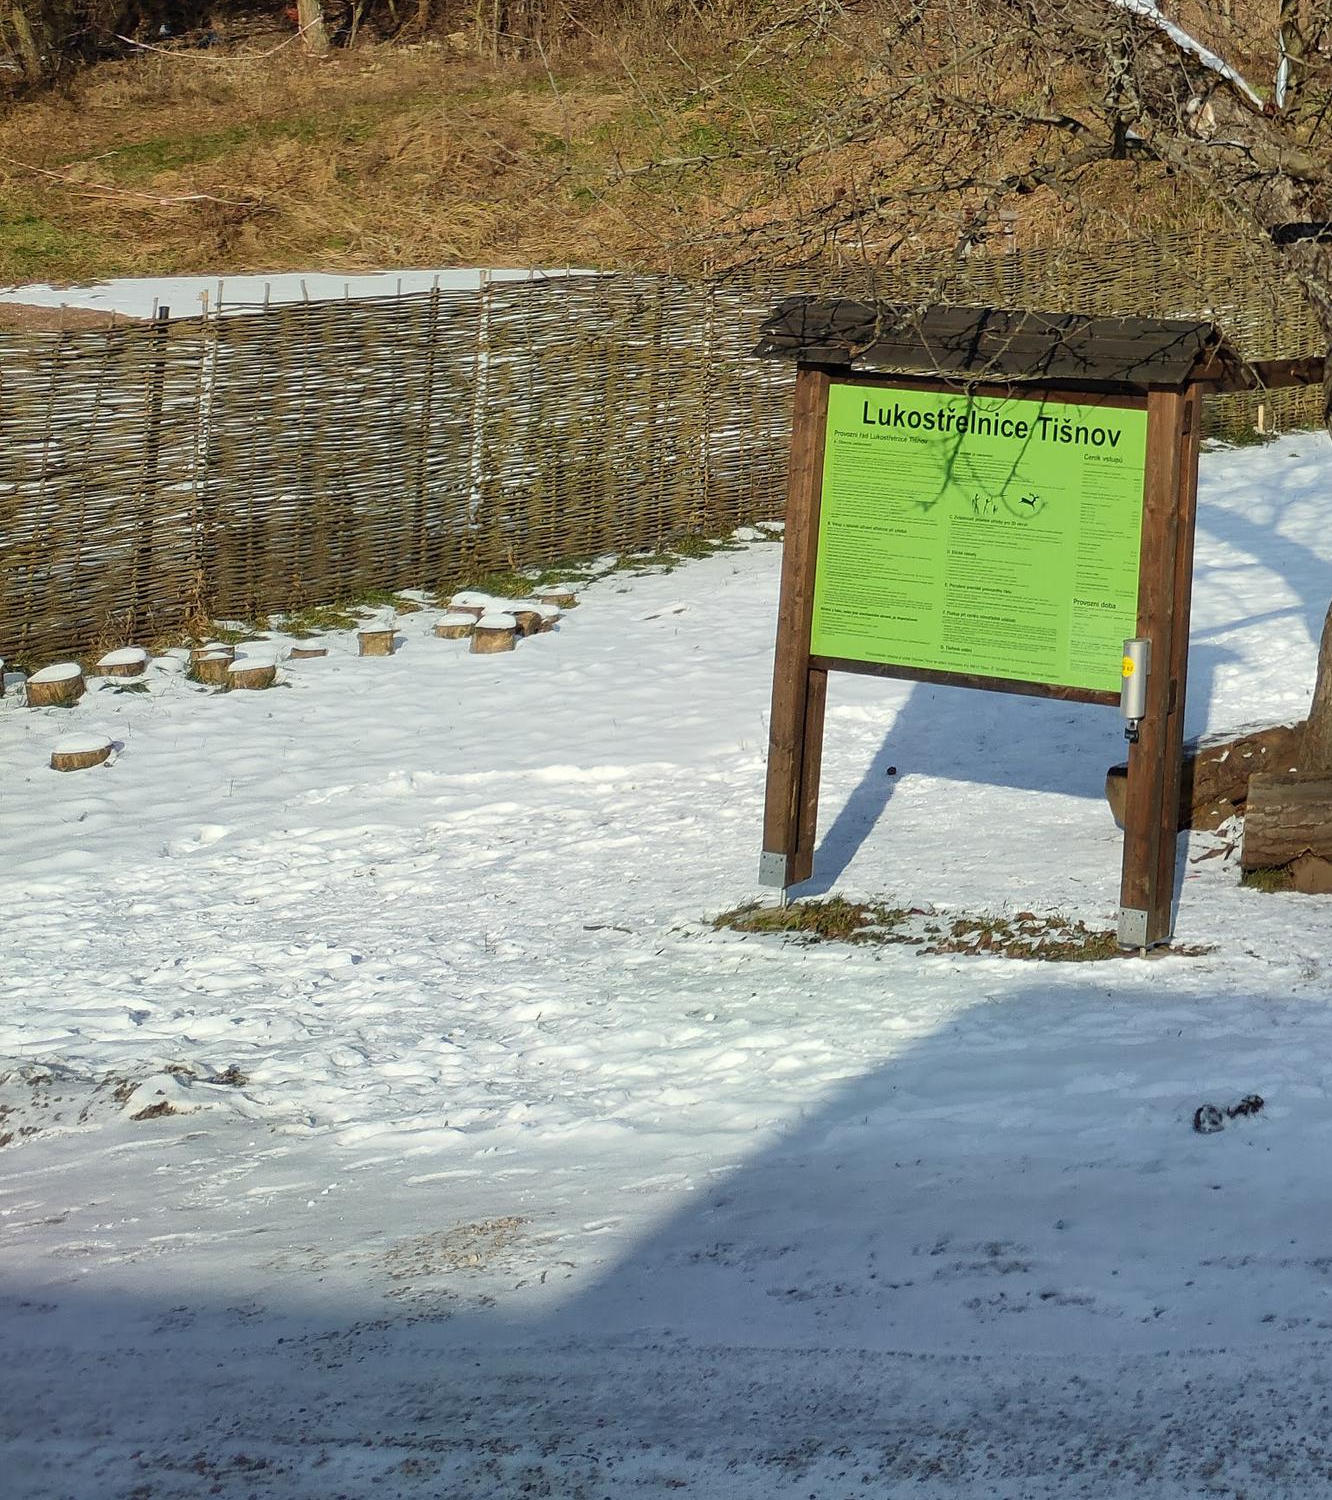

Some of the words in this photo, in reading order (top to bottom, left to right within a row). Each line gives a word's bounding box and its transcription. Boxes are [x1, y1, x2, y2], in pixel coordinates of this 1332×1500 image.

[863, 401, 1028, 440] Lukostřelnice
[1039, 416, 1121, 447] Tišnov
[1100, 601, 1116, 609] doba
